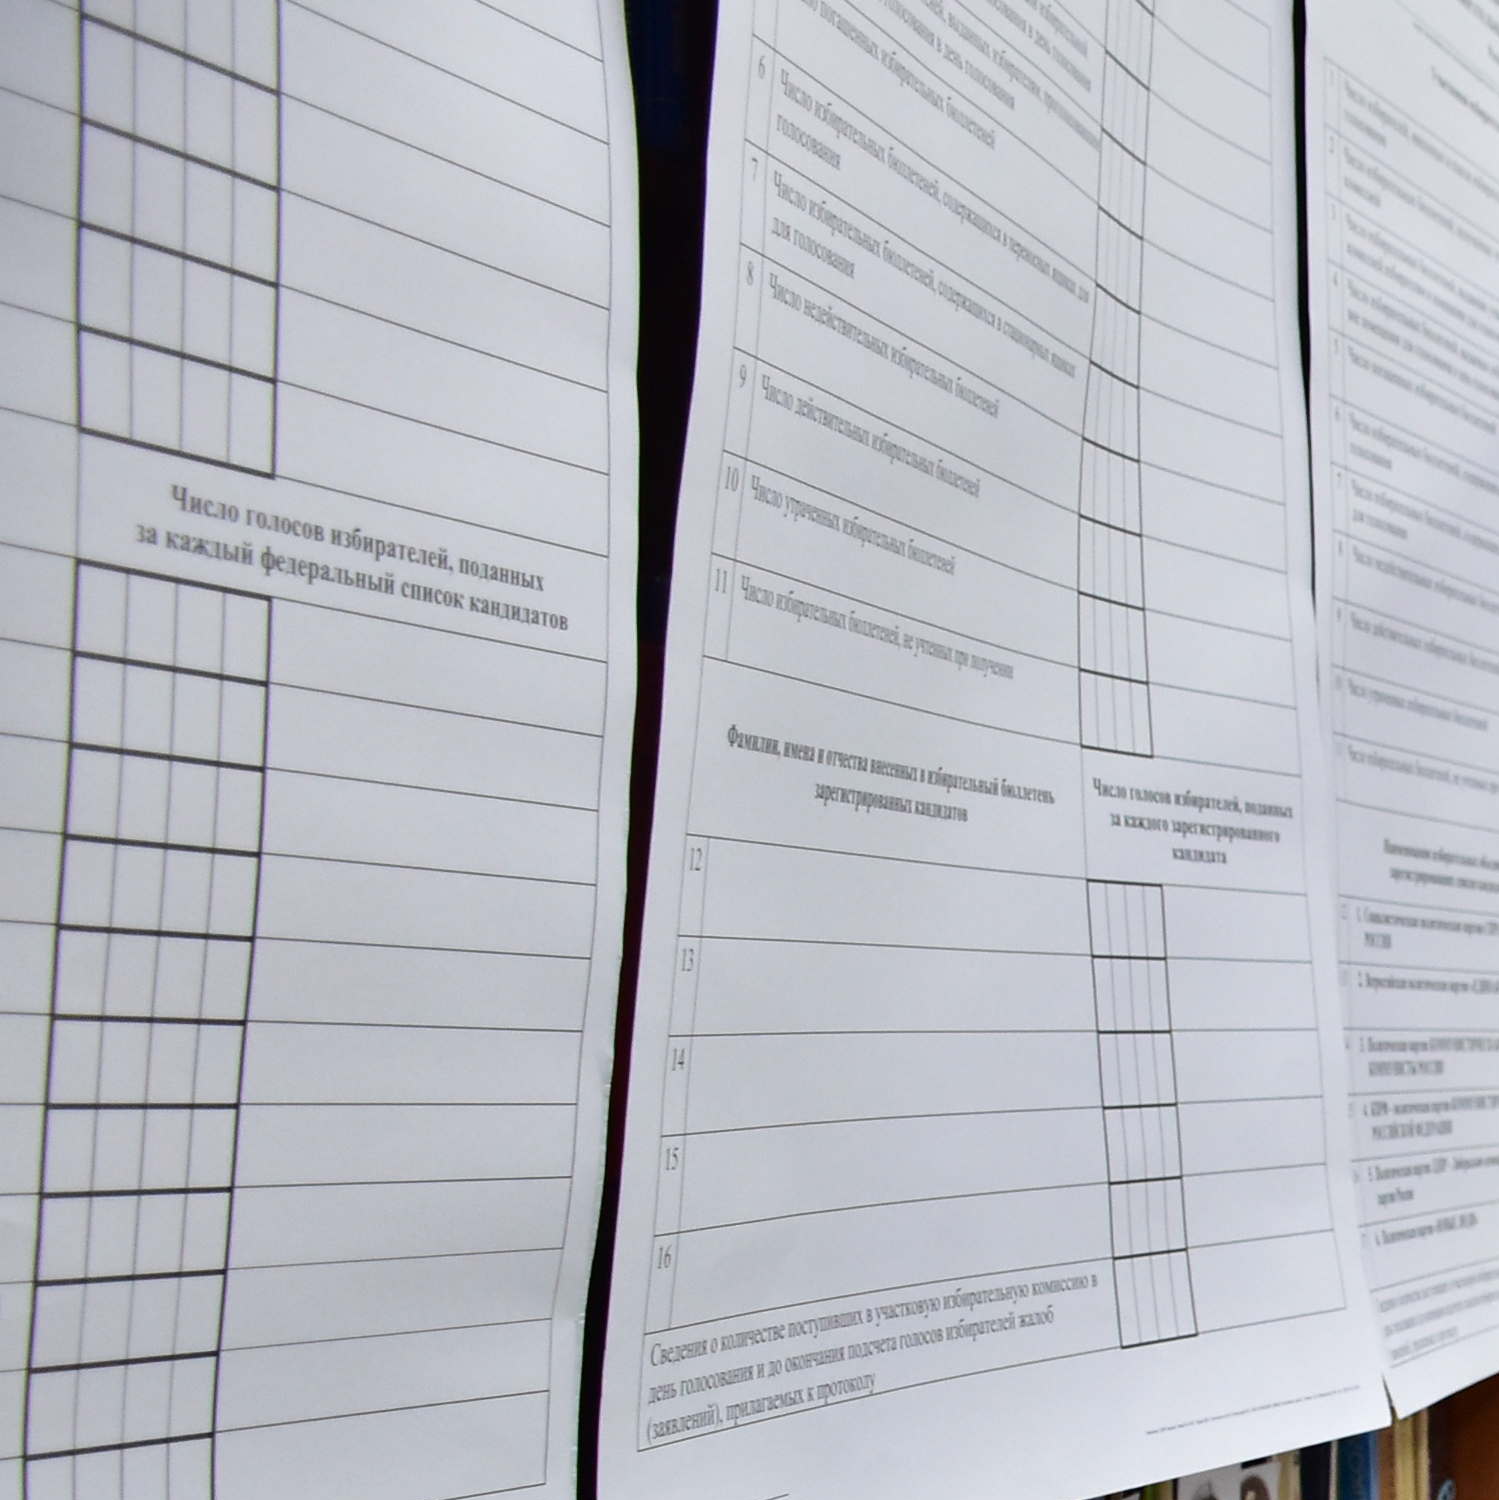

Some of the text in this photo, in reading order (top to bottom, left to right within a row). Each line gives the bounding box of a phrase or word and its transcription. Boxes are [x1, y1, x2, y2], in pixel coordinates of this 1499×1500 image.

[759, 56, 767, 79] 6
[781, 68, 813, 111] Число
[814, 102, 886, 163] избирательных
[777, 114, 840, 170] голосования
[752, 158, 758, 181] 7
[774, 170, 807, 211] Число
[809, 200, 881, 257] избирательных
[746, 261, 754, 285] 8
[794, 229, 855, 280] голосования
[769, 272, 802, 311] Число
[890, 346, 954, 394] избирательных
[740, 364, 748, 388] 9
[762, 374, 794, 410] Число
[871, 432, 934, 476] избирательных
[725, 466, 740, 491] 10
[751, 475, 782, 509] Число
[784, 495, 840, 531] утраченных
[842, 516, 906, 557] избирательных
[172, 484, 545, 592] Число голосов избирателей, поданных
[136, 524, 569, 632] за каждый федеральный список кандидатов
[715, 568, 728, 594] 11
[741, 575, 774, 607] Число
[776, 590, 846, 629] избирательных
[784, 741, 815, 762] имена
[826, 749, 868, 772] отчества
[870, 758, 918, 782] внесенных
[927, 766, 999, 795] избирательный
[1000, 778, 1055, 804] бюллетень
[814, 783, 968, 822] зарегистрированных кандидатов
[1093, 777, 1127, 800] Число
[1129, 787, 1172, 805] голосов
[1244, 801, 1293, 819] поданных
[1109, 813, 1281, 844] за каждого зарегистрированного
[689, 847, 703, 872] 12
[1172, 847, 1228, 864] кандидата
[681, 948, 695, 972] 13
[672, 1047, 686, 1072] 14
[665, 1147, 679, 1171] 15
[657, 1244, 672, 1270] 16
[650, 1339, 708, 1367] Сведения
[710, 1338, 718, 1354] о
[720, 1323, 787, 1353] количестве
[788, 1310, 864, 1339] поступивших
[875, 1296, 941, 1327] участковую
[943, 1284, 1029, 1311] избирательную
[1031, 1275, 1089, 1297] комиссию
[647, 1304, 1054, 1405] день голосования и до окончания подсчета голосов избирателей жалоб
[646, 1373, 876, 1445] (заявлений), прилагаемых к протоколу
